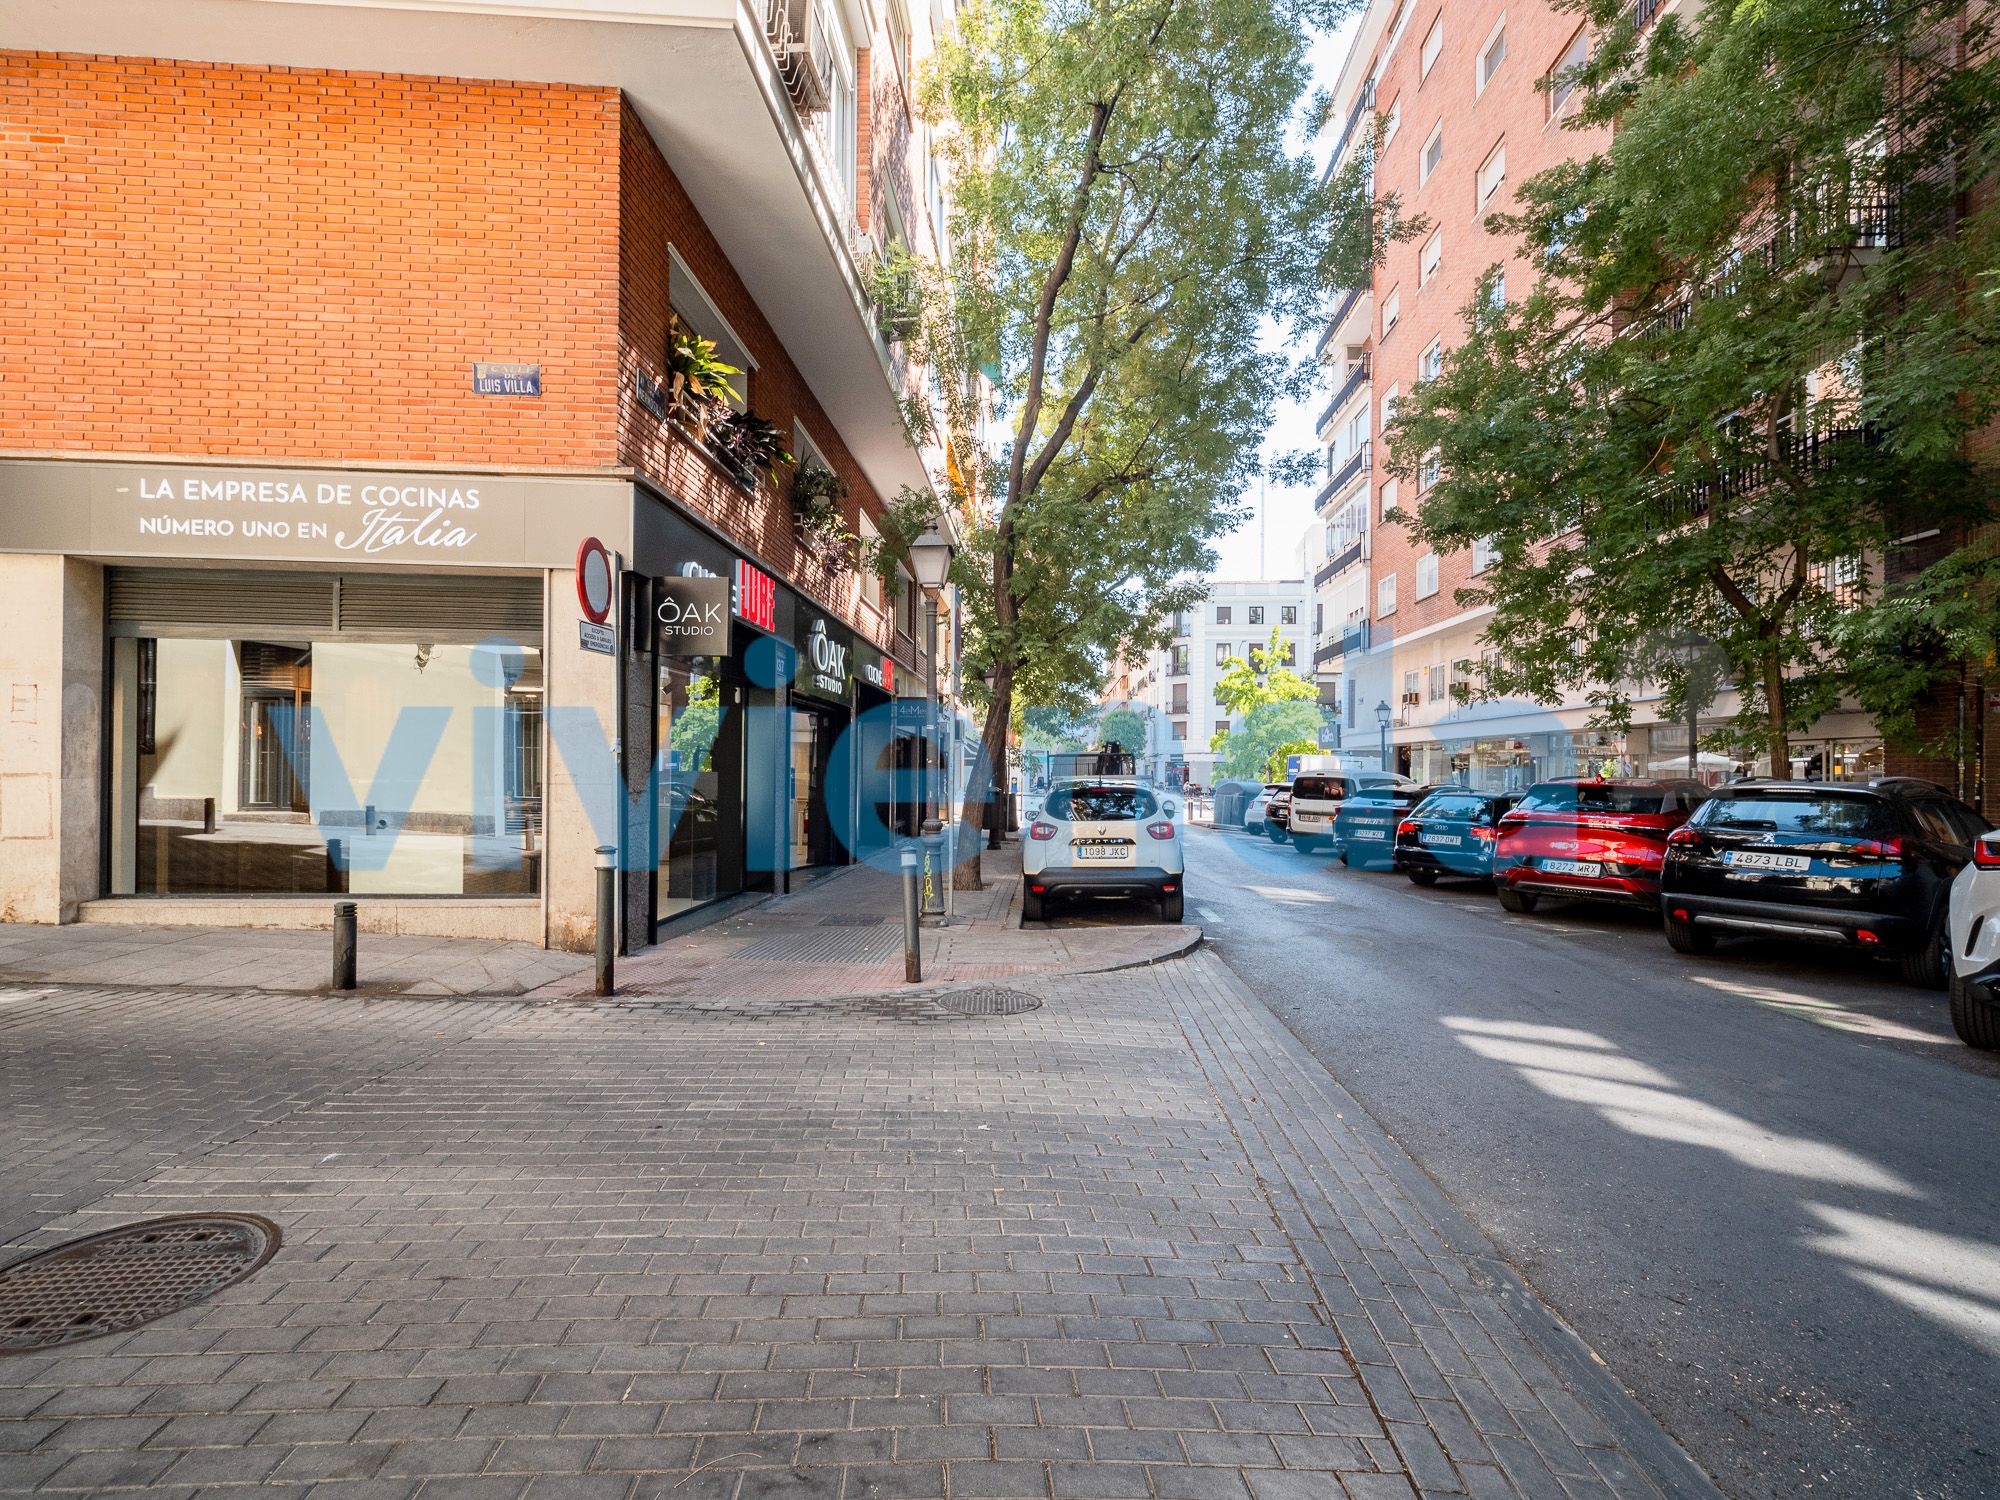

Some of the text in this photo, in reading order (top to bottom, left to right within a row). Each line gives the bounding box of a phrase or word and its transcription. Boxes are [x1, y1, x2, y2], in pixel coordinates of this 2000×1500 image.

[480, 378, 534, 393] LUIS VILLA
[139, 477, 480, 510] LA EMPRESA DE COCINAS
[139, 507, 478, 553] NÚMERO UNO EN Italia
[737, 558, 776, 633] LUBE
[657, 596, 722, 624] ÔAK
[664, 625, 714, 636] STUDIO
[814, 618, 846, 680] ÔAK
[818, 674, 843, 695] STUDIO
[1084, 847, 1126, 856] 1098 JKC
[1549, 860, 1575, 872] 8272
[1577, 864, 1598, 874] MRX
[1735, 854, 1771, 866] 4873
[1775, 856, 1803, 869] LBL
[96, 1244, 216, 1257] REGISTRO
